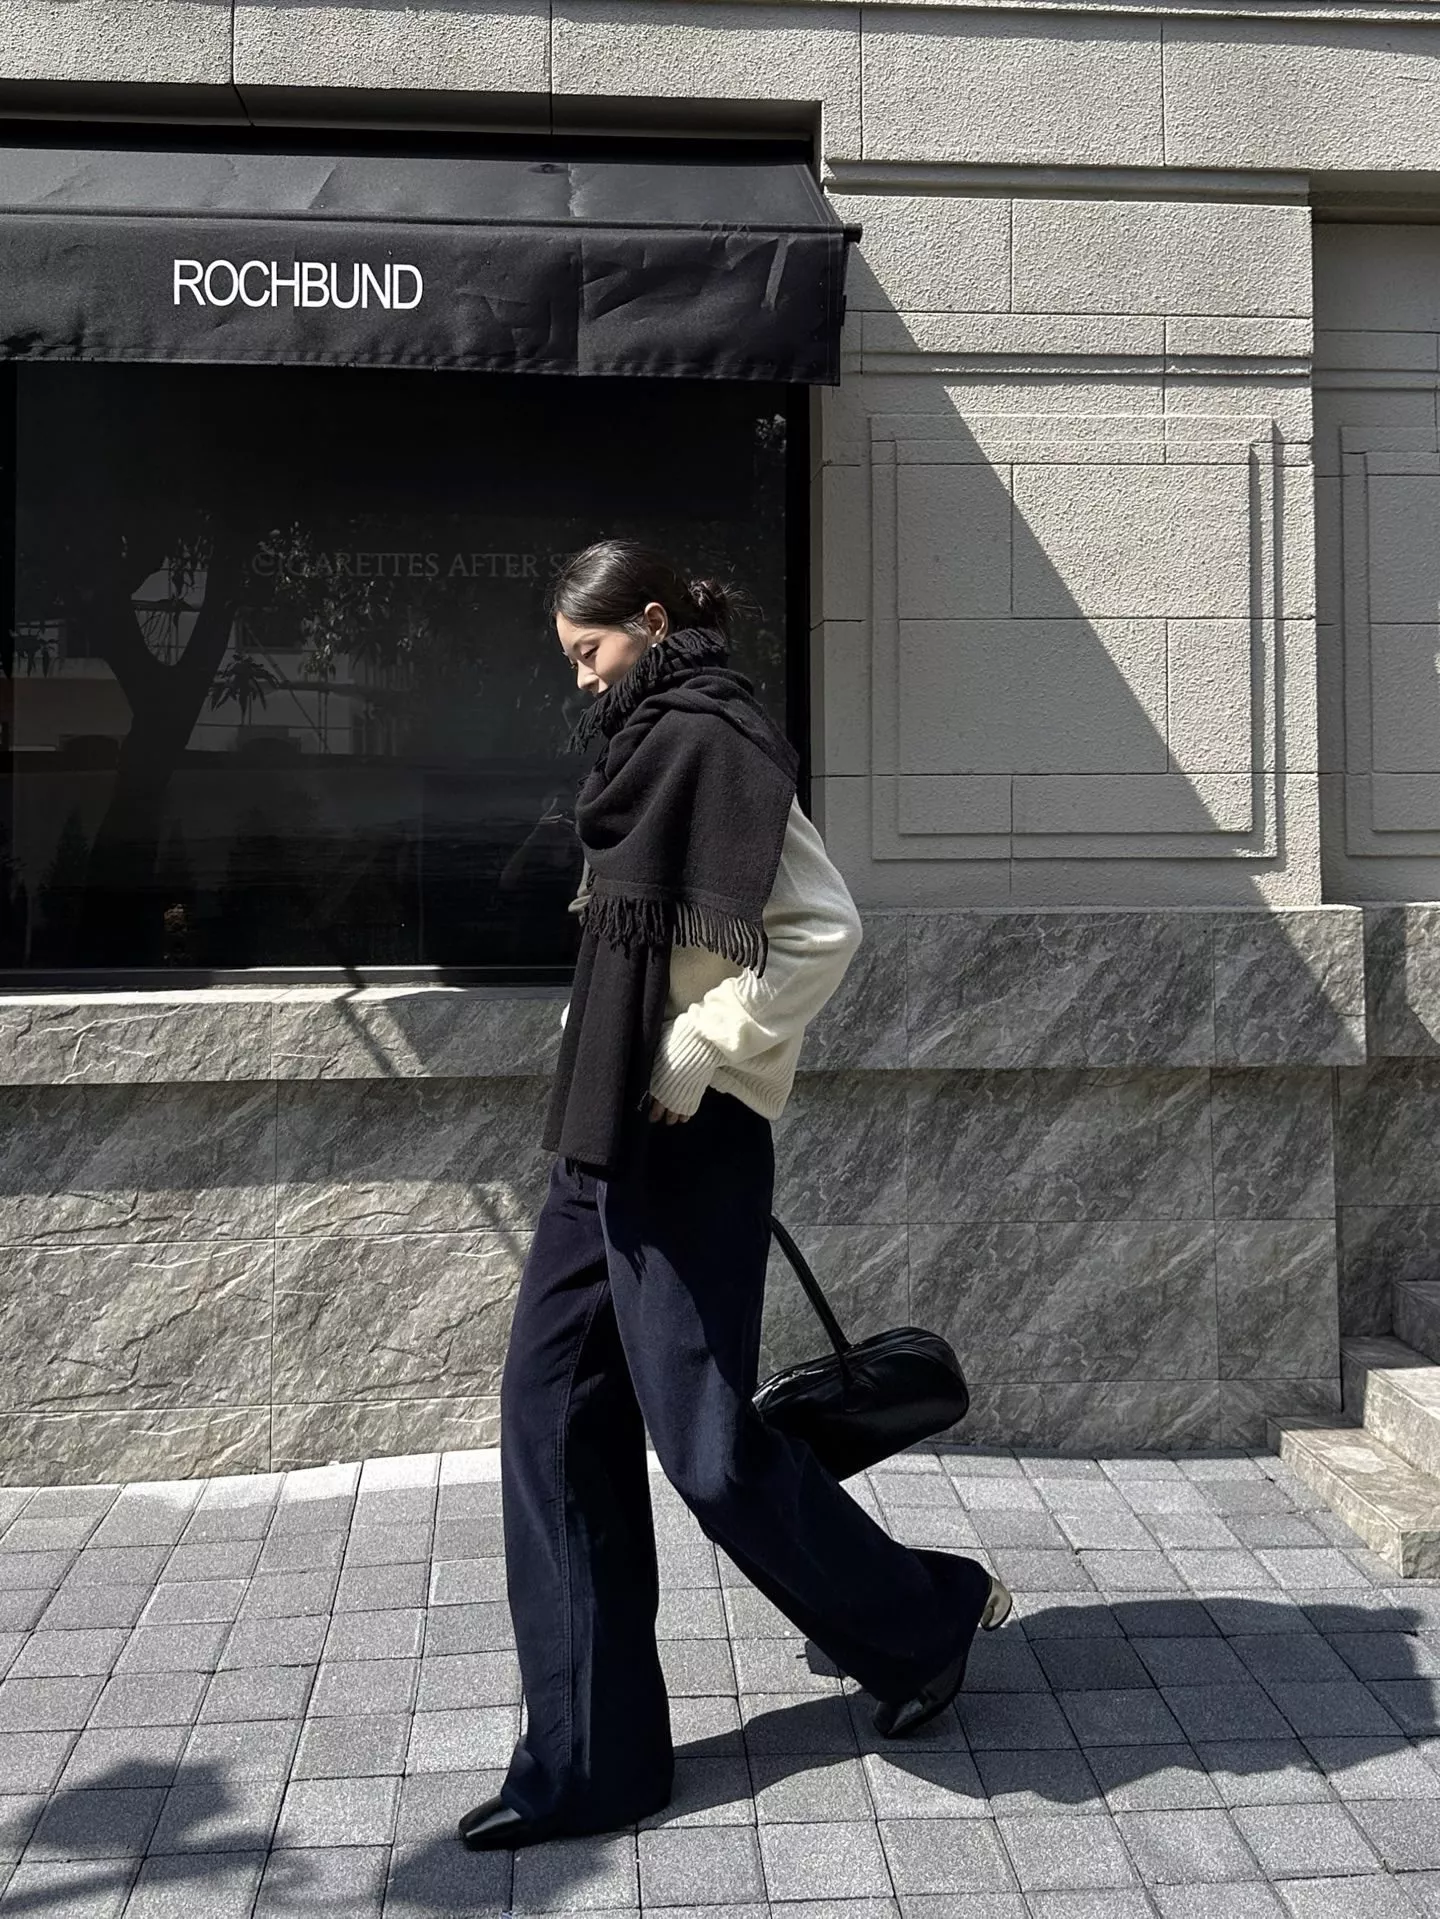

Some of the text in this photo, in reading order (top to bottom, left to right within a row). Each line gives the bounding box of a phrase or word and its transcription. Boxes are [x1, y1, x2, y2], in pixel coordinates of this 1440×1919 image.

[173, 259, 423, 309] ROCHBUND
[252, 552, 439, 577] CIGARETTES
[447, 552, 540, 578] AFTER
